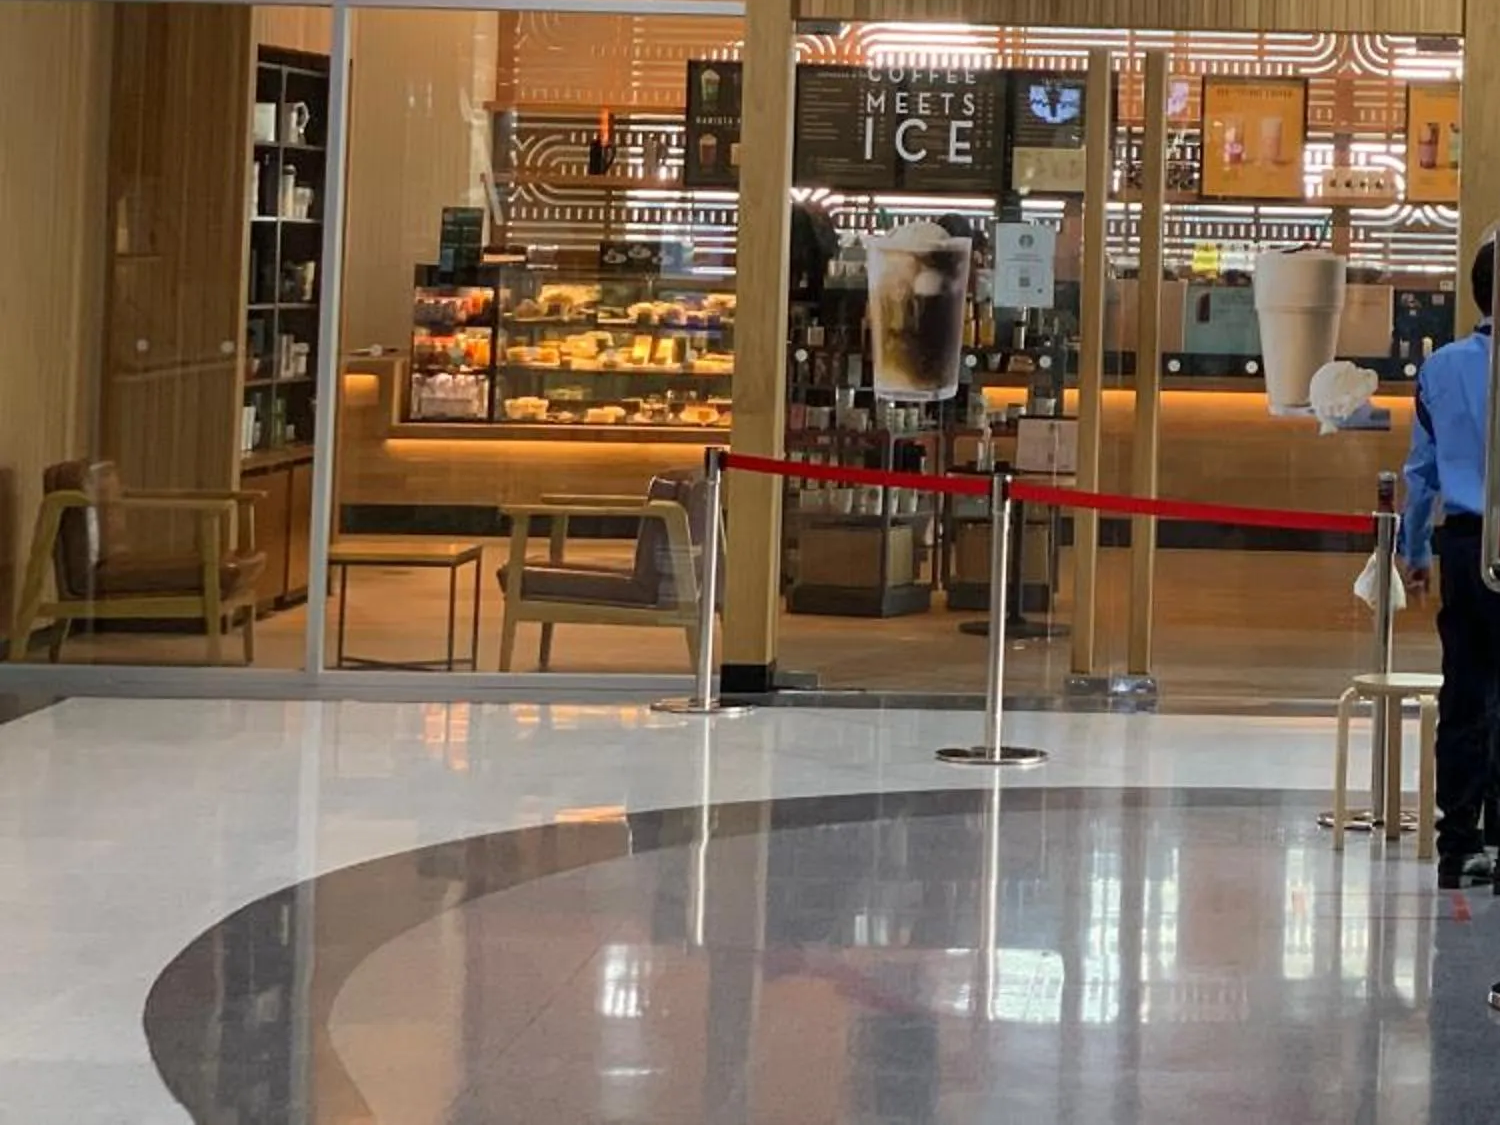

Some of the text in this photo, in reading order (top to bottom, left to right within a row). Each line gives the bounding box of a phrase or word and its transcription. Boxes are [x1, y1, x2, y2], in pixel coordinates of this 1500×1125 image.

[867, 66, 976, 84] COFFEE
[866, 92, 976, 116] MEETS
[864, 116, 974, 164] ICE
